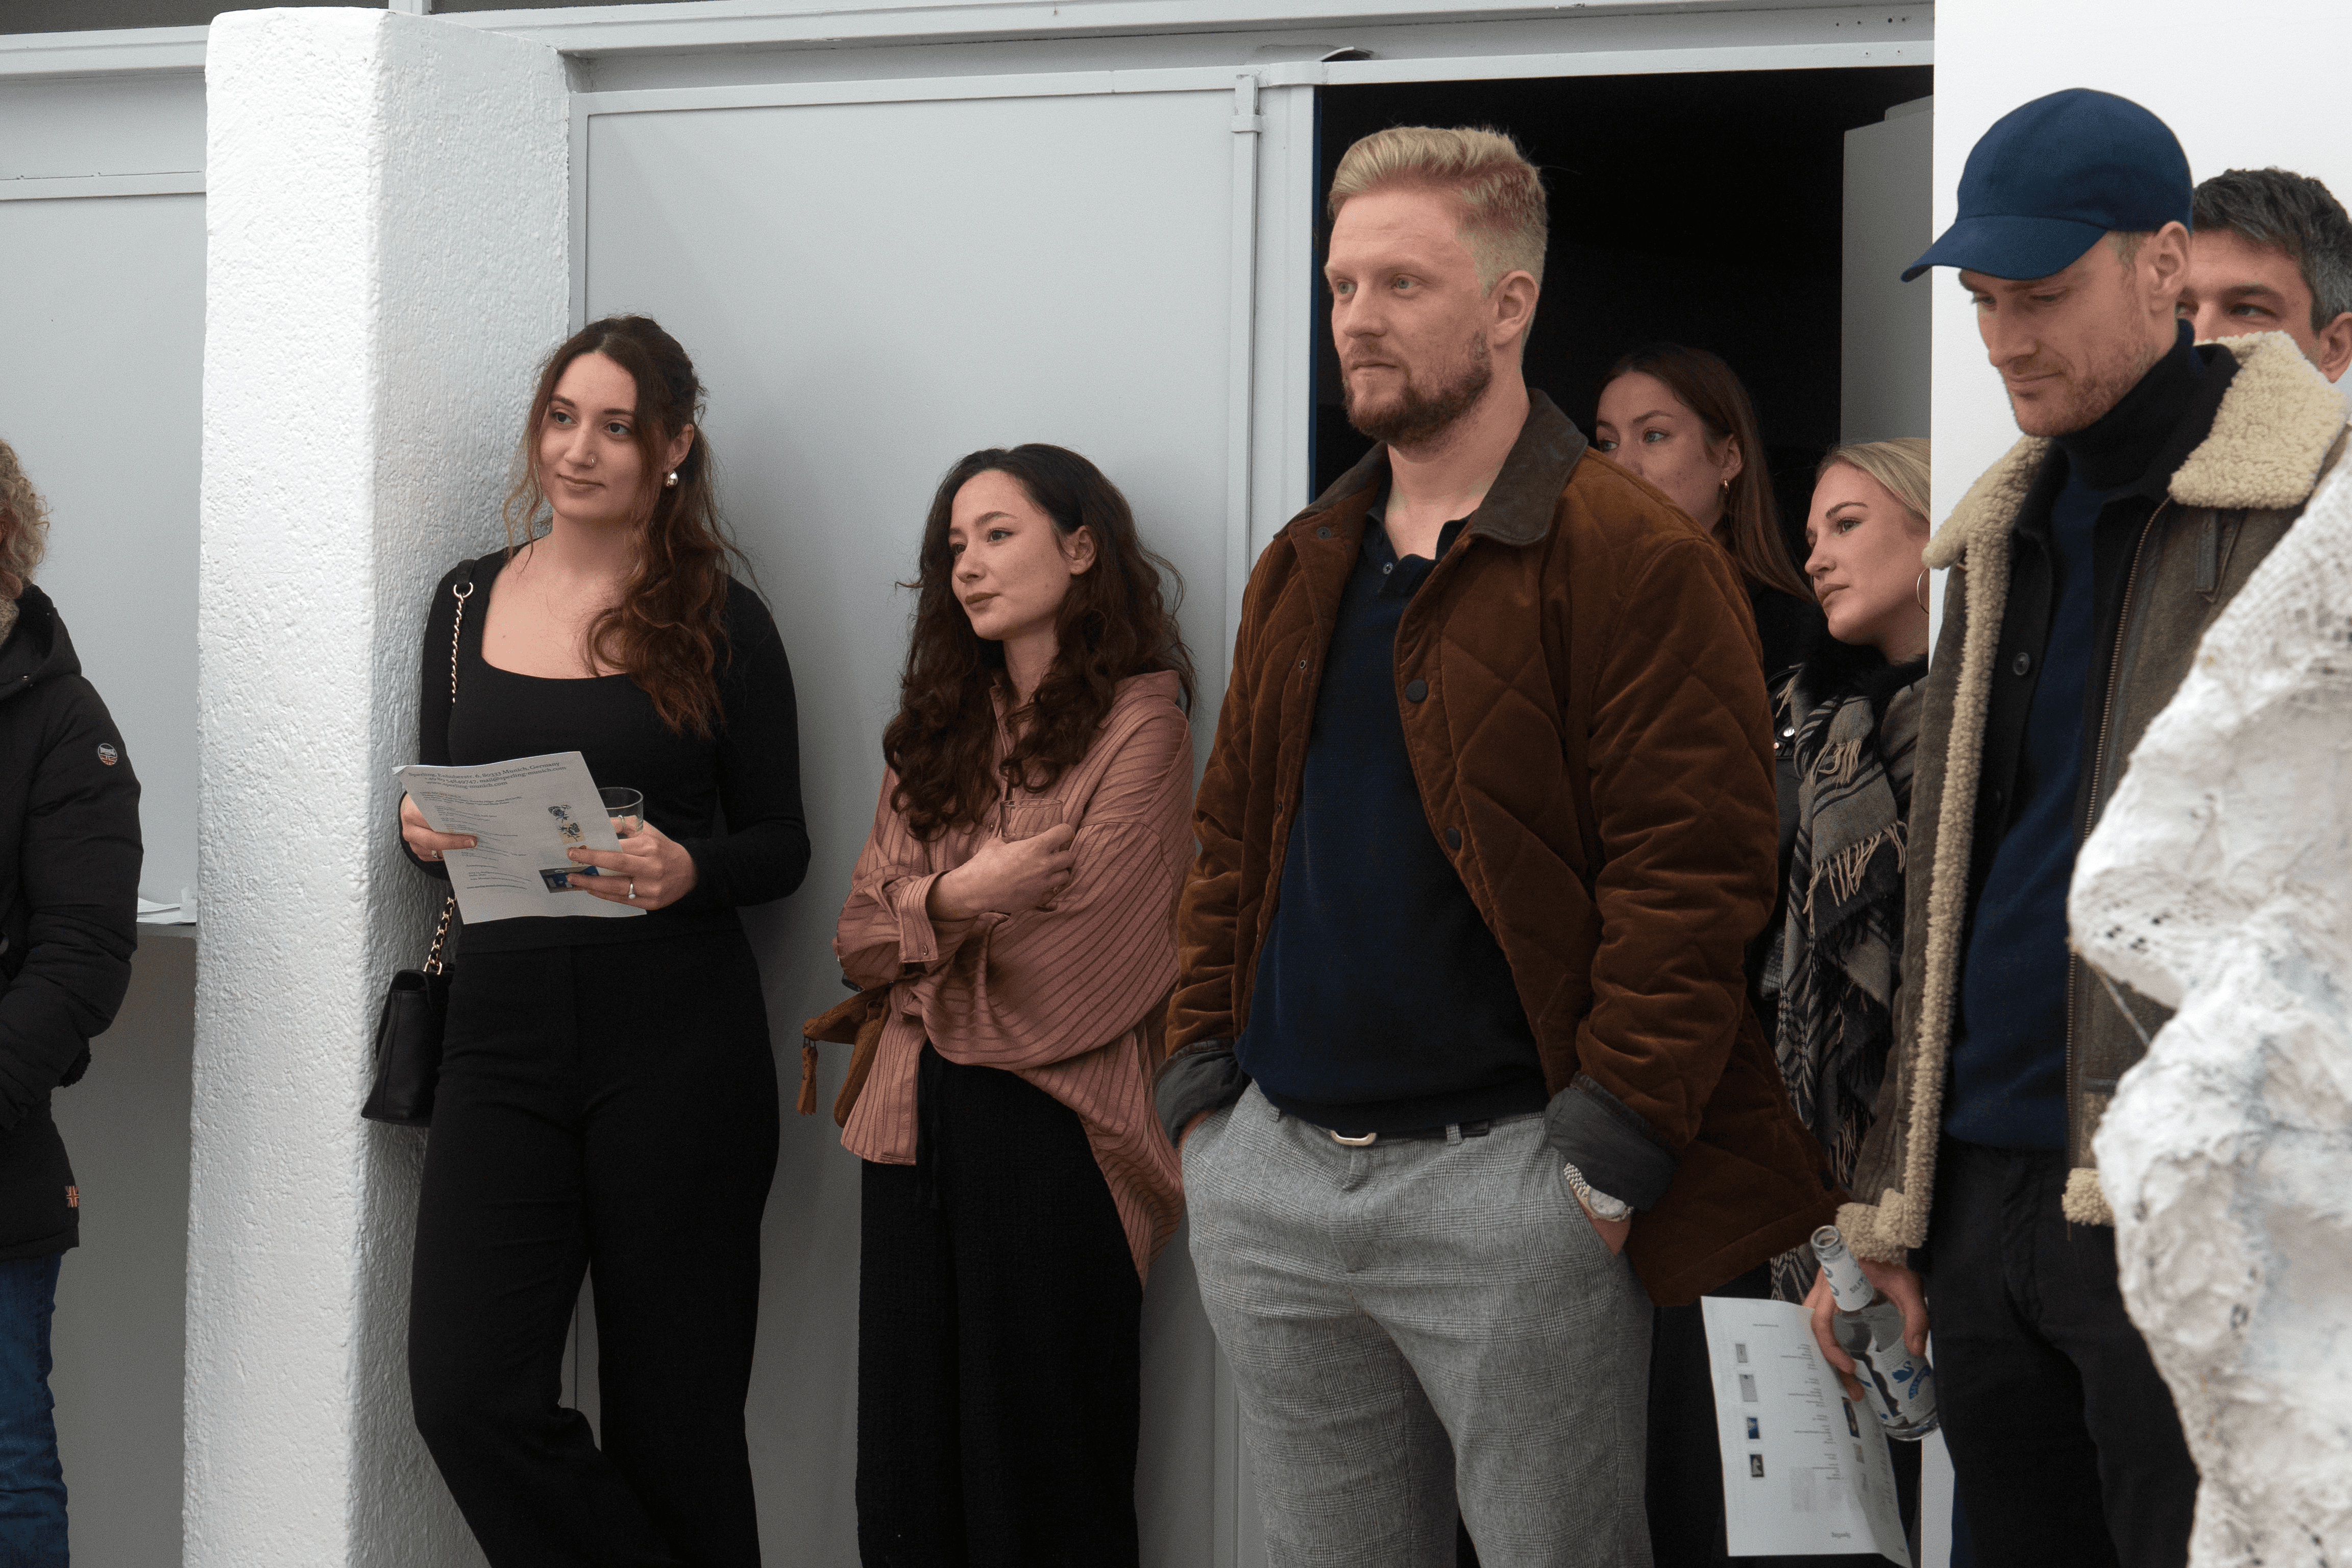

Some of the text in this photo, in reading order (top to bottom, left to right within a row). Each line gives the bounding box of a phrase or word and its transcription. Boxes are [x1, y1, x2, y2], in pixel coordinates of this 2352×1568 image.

[480, 766, 567, 783] mail@sperling-munich.com
[502, 767, 529, 775] Munich,
[530, 762, 560, 770] Germany
[426, 781, 508, 789] www.sperling-munich.com
